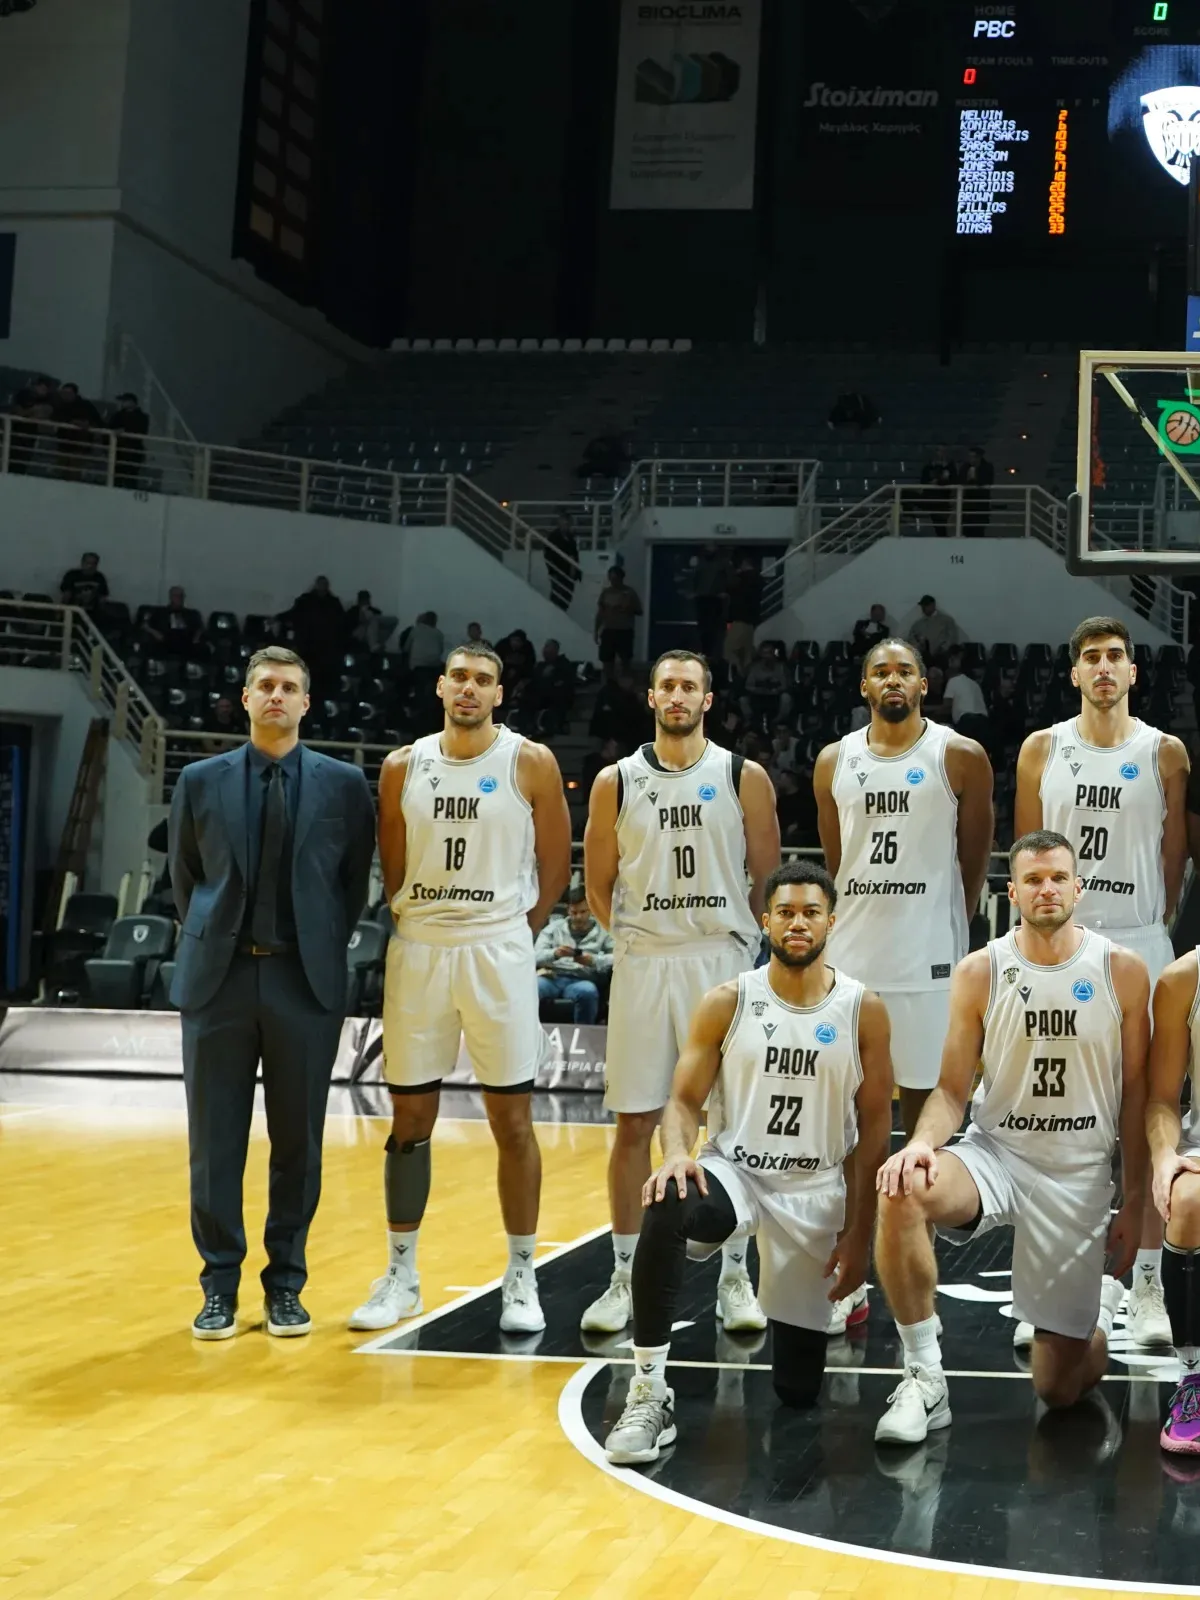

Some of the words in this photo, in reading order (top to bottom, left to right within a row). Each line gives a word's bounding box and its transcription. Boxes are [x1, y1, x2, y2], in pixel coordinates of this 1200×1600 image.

[638, 5, 741, 18] BIOCLIMA
[974, 5, 1016, 16] HOME
[1153, 2, 1168, 21] 0
[972, 20, 1016, 38] PBC
[1133, 26, 1170, 37] SCORE
[966, 56, 996, 66] TEAM
[998, 56, 1034, 66] FOULS
[1051, 56, 1109, 66] TIME-OUTS
[962, 68, 977, 85] 0
[803, 82, 939, 107] Stoiximan
[960, 110, 1003, 120] MELVIN
[960, 120, 1016, 130] KONIARIS
[960, 130, 1030, 141] SLAFTSAKIS
[959, 141, 995, 151] ZARAS
[959, 150, 1009, 161] JACKSON
[959, 161, 994, 171] JONES
[958, 171, 1015, 182] PERSIDIS
[959, 181, 1014, 192] IATRIDIS
[957, 191, 993, 202] BROWN
[957, 202, 1007, 213] FILLIOS
[957, 212, 992, 223] MOORE
[956, 223, 992, 234] DIMSA
[950, 555, 964, 564] 114
[865, 790, 910, 814] PAOK
[1075, 784, 1122, 809] PAOK
[434, 797, 480, 819] PAOK
[659, 804, 702, 830] PAOK
[870, 831, 897, 865] 26
[1079, 825, 1108, 861] 20
[443, 837, 466, 871] 18
[672, 845, 696, 879] 10
[409, 883, 495, 902] Stoiximan
[844, 878, 927, 896] Stoiximan
[642, 893, 727, 912] Stoiximan
[1025, 1009, 1077, 1037] PAOK
[765, 1046, 819, 1077] PAOK
[1032, 1058, 1066, 1097] 33
[766, 1095, 803, 1137] 22
[999, 1110, 1097, 1132] Stoiximan
